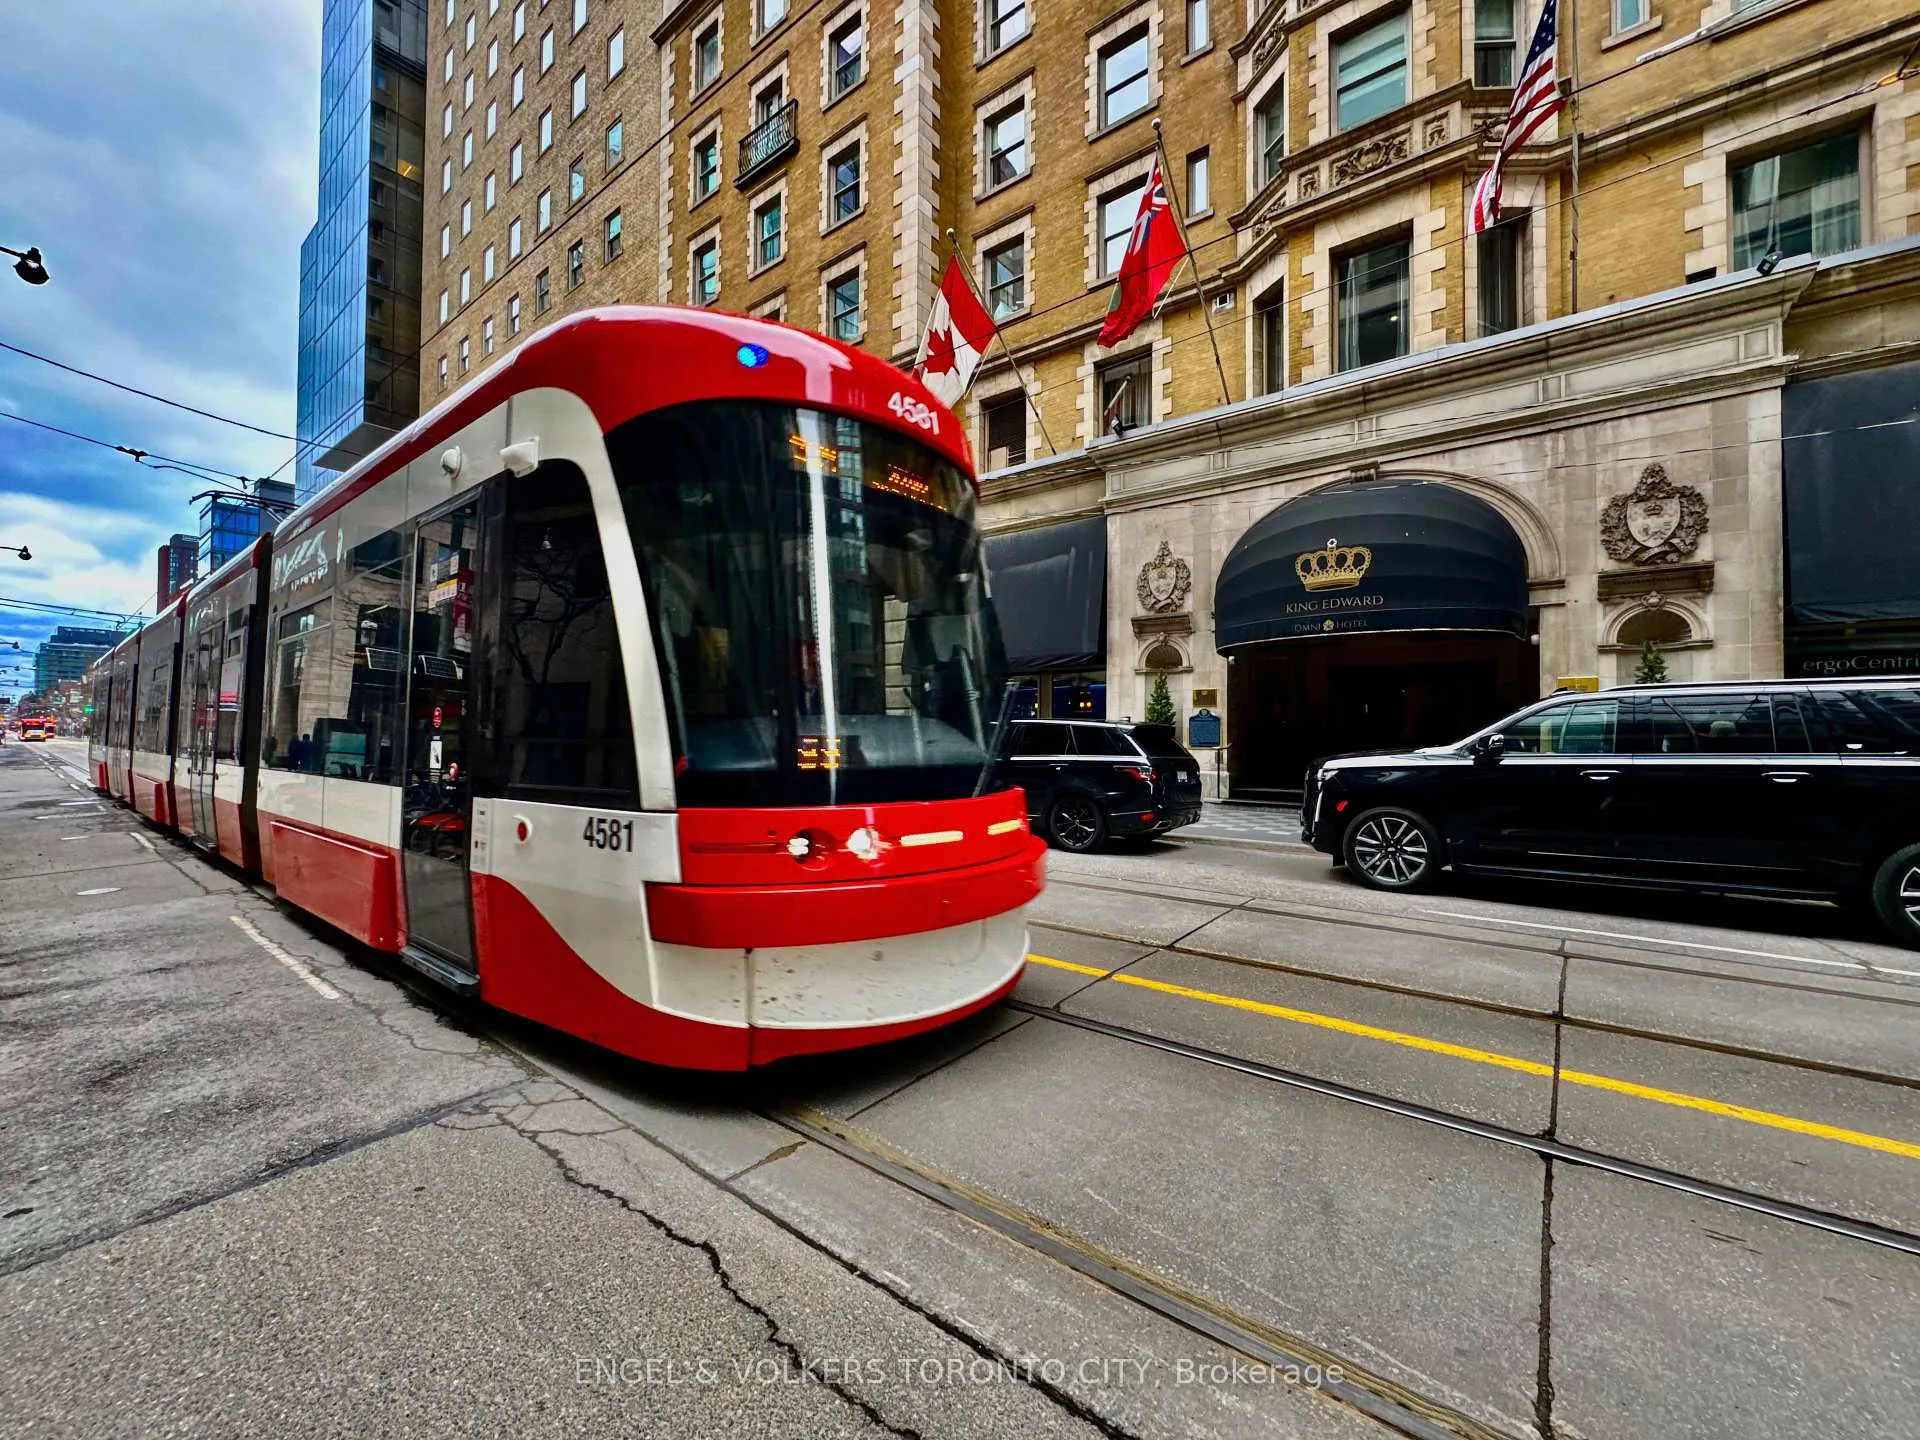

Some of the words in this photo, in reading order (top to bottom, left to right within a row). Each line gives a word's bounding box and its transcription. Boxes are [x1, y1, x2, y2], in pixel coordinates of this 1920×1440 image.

[1285, 600, 1319, 614] KING
[1322, 595, 1384, 610] EDWARD
[1336, 619, 1369, 629] HOTEL
[583, 816, 633, 853] 4581
